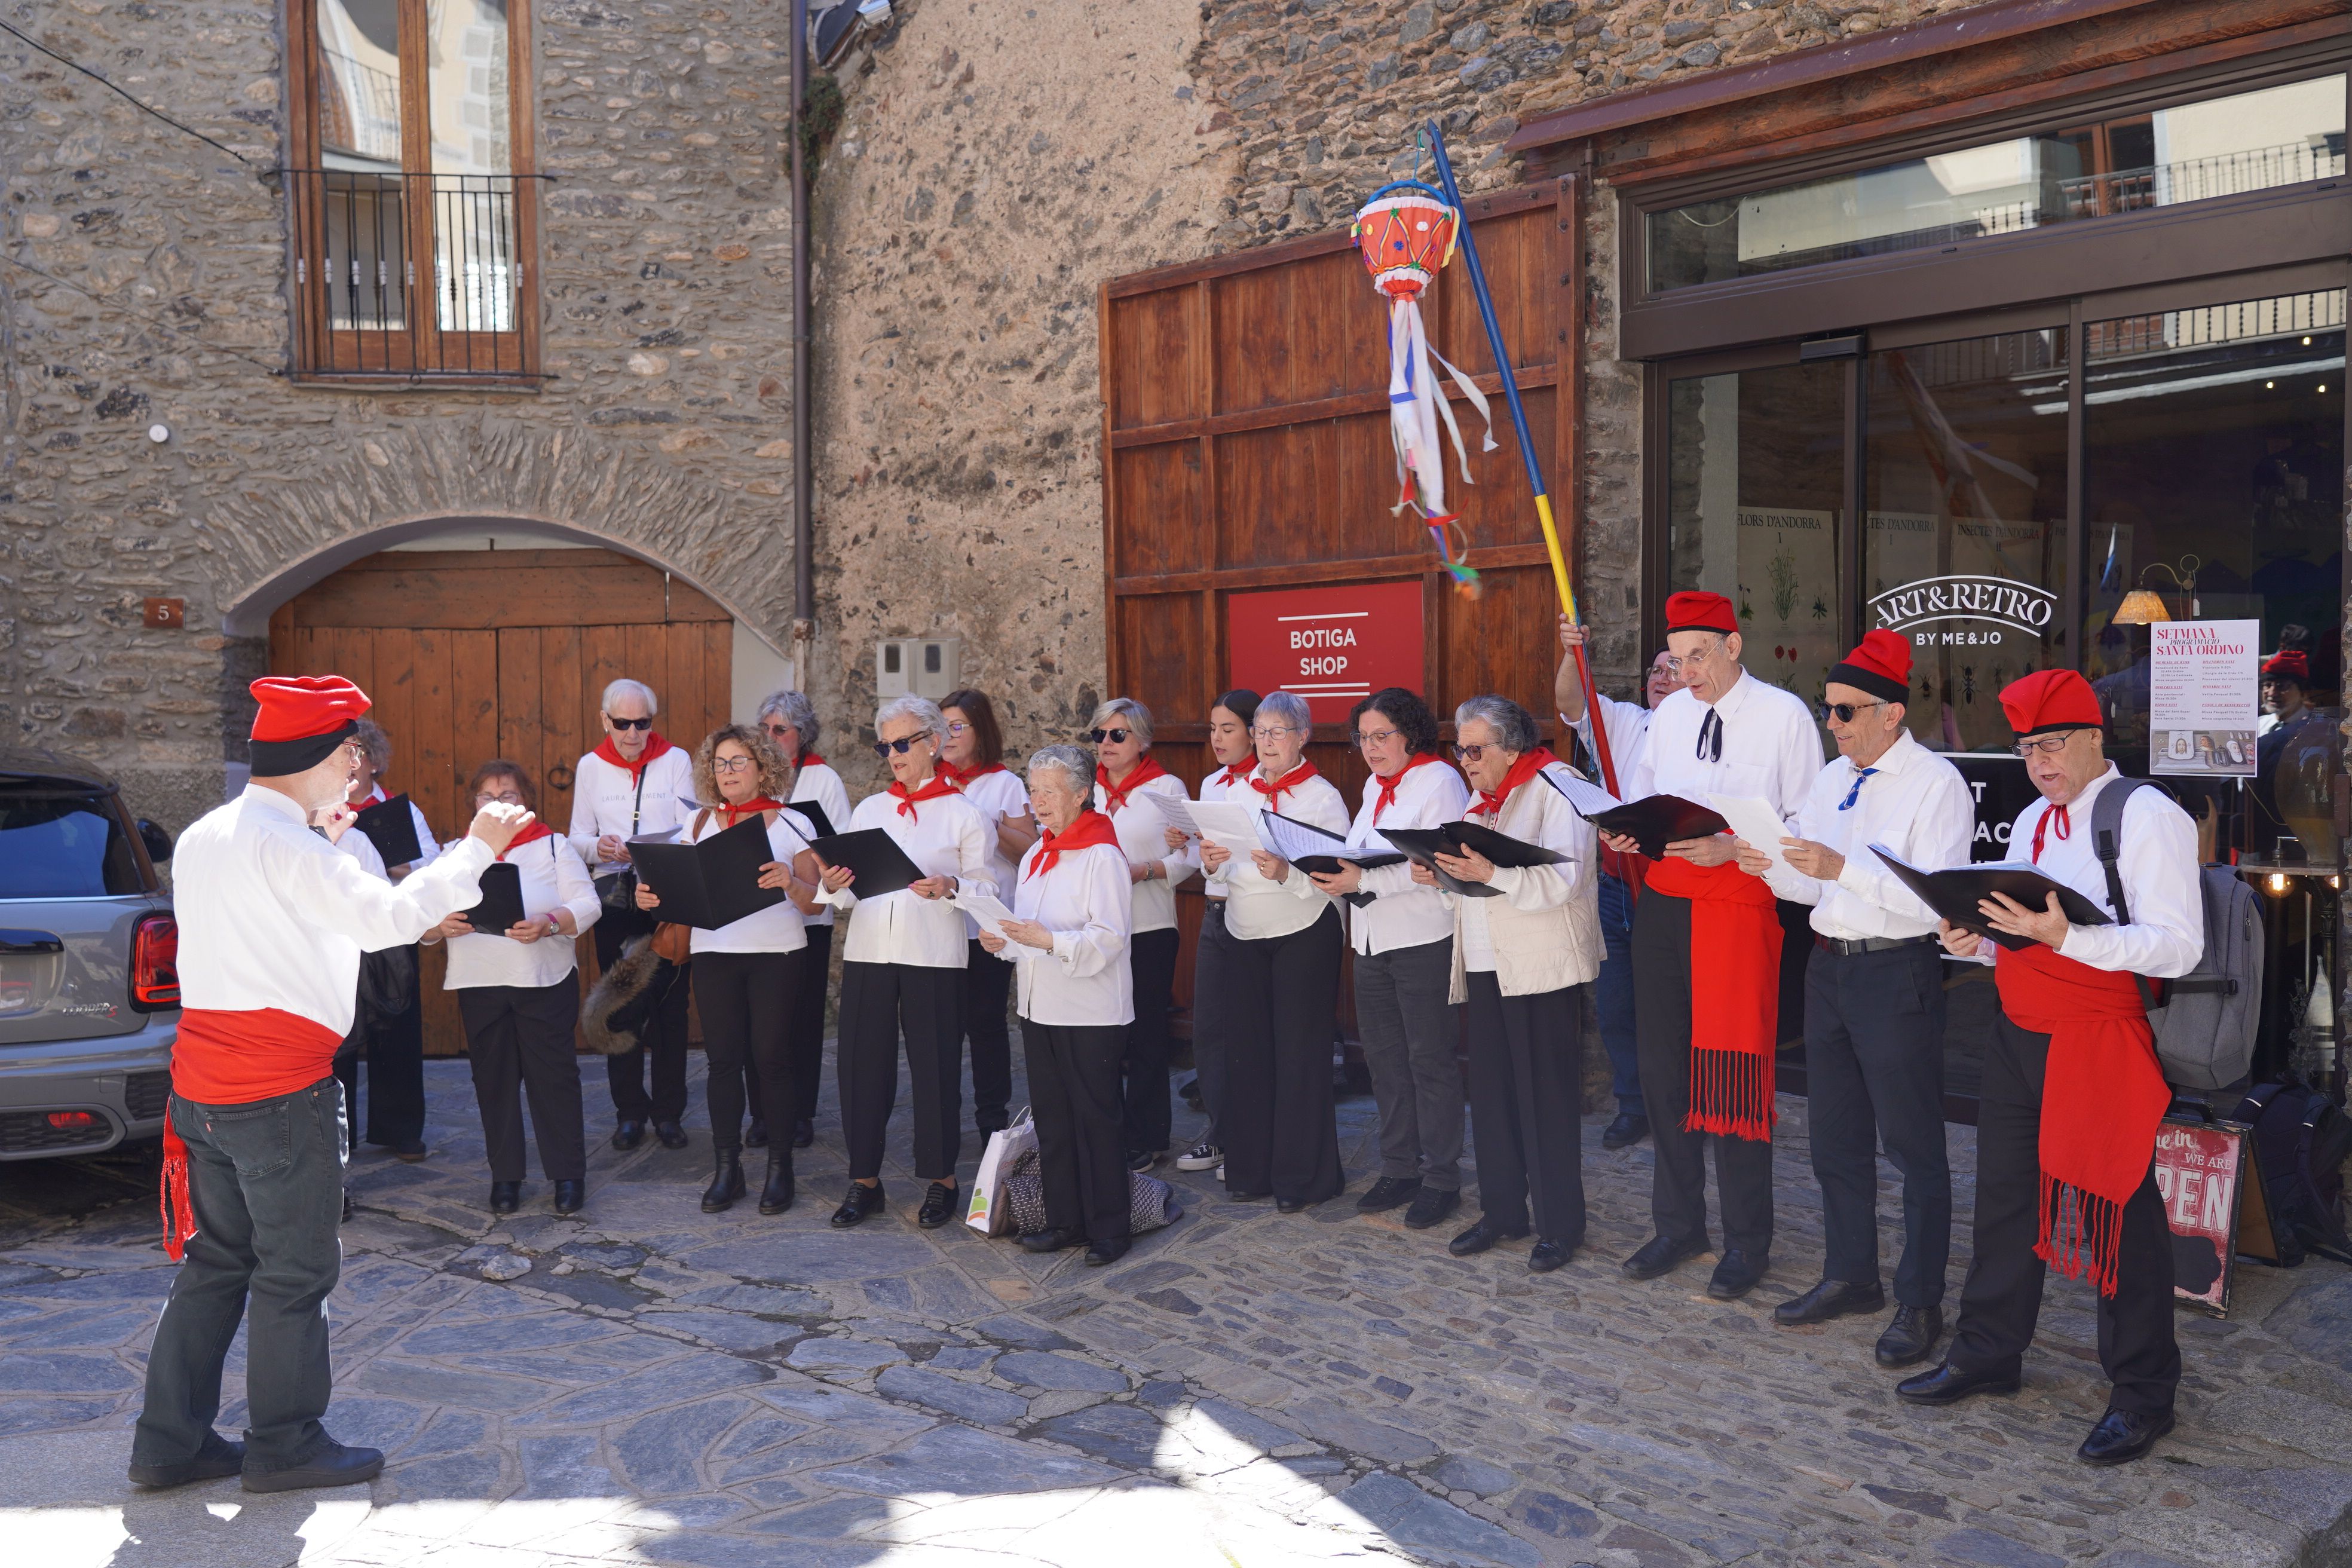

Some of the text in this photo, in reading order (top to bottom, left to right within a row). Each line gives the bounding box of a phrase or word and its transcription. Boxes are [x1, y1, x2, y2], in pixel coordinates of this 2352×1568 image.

[1766, 515, 1821, 529] D'ANDORRA
[1888, 519, 1935, 532] D'ANDORRA
[1958, 524, 1993, 537] INSECTES
[158, 605, 170, 621] 5
[1290, 628, 1357, 649] BOTIGA
[1916, 632, 1937, 646] BY
[2157, 628, 2216, 640] SETMANA
[2157, 644, 2244, 656] SANTA ORDINO
[1300, 656, 1348, 676] SHOP
[2175, 1129, 2195, 1147] in
[2185, 1153, 2232, 1170] WE ARE
[2155, 1163, 2234, 1233] PEN
